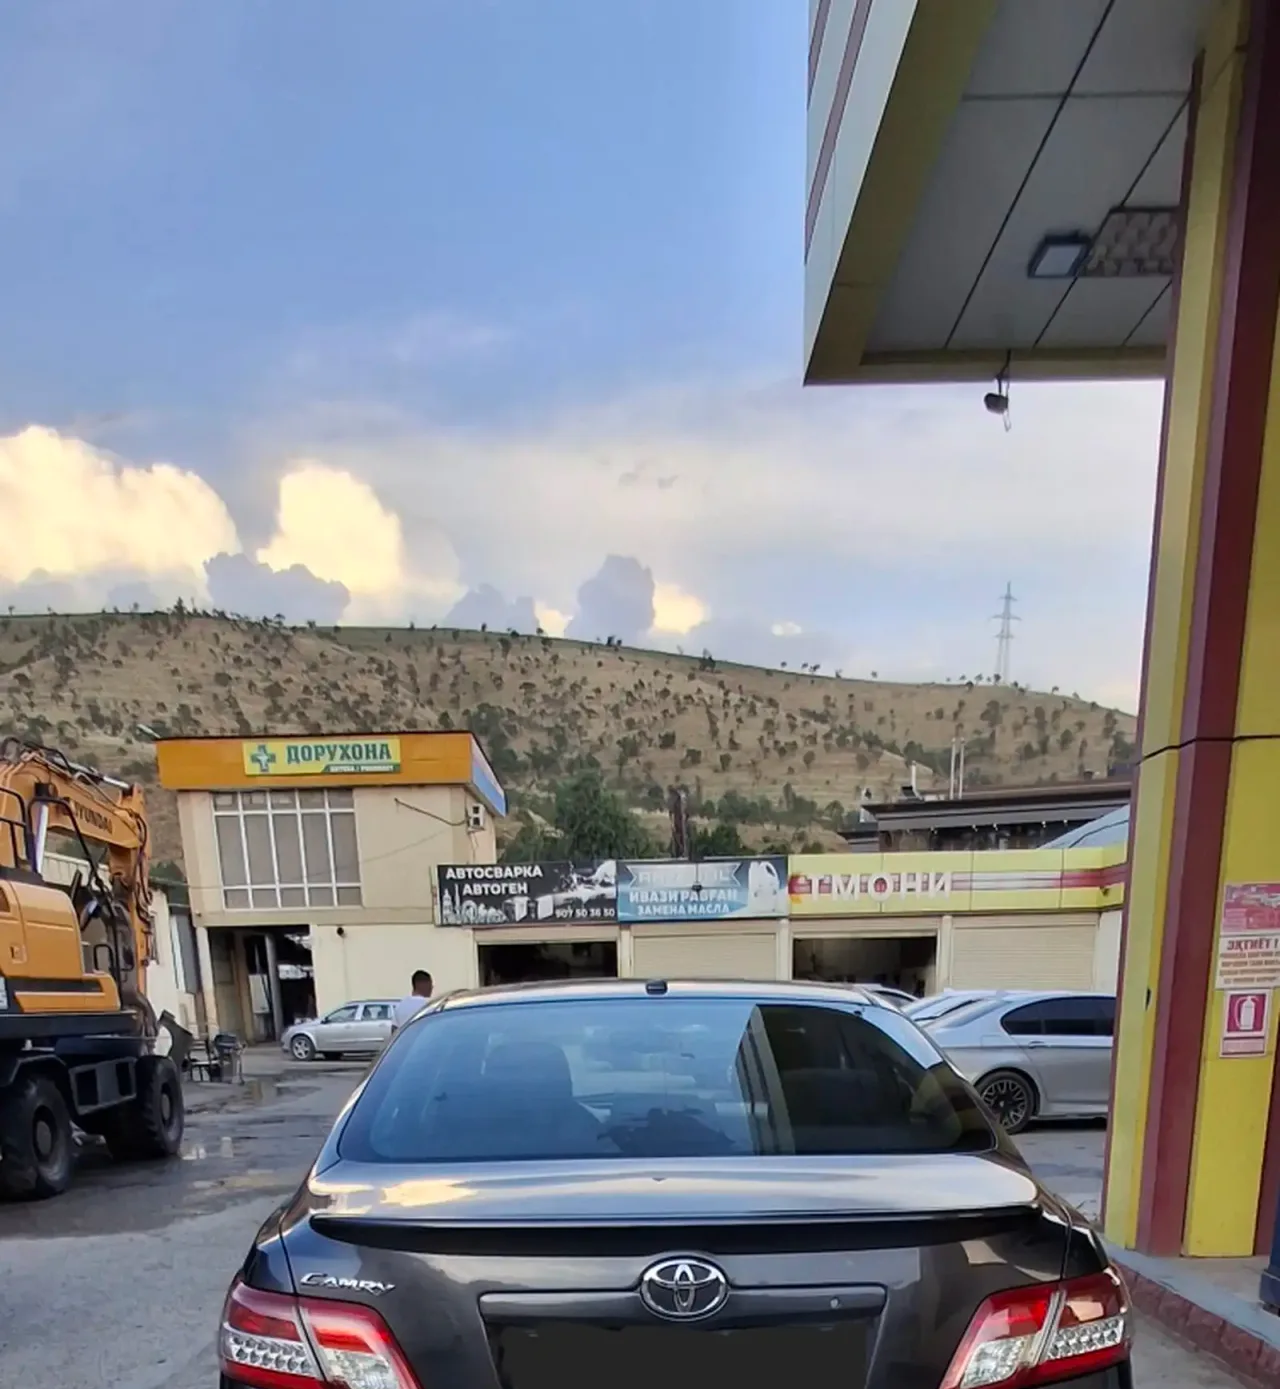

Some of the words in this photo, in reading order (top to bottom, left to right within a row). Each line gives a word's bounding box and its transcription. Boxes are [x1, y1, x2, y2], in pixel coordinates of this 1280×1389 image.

[287, 743, 392, 764] ДОРУХОНА
[446, 865, 543, 880] АВТОСВАРКА
[462, 882, 528, 896] АВТОГЕН
[637, 904, 686, 916] ЗАМЕНА
[687, 903, 730, 915] МАСЛА
